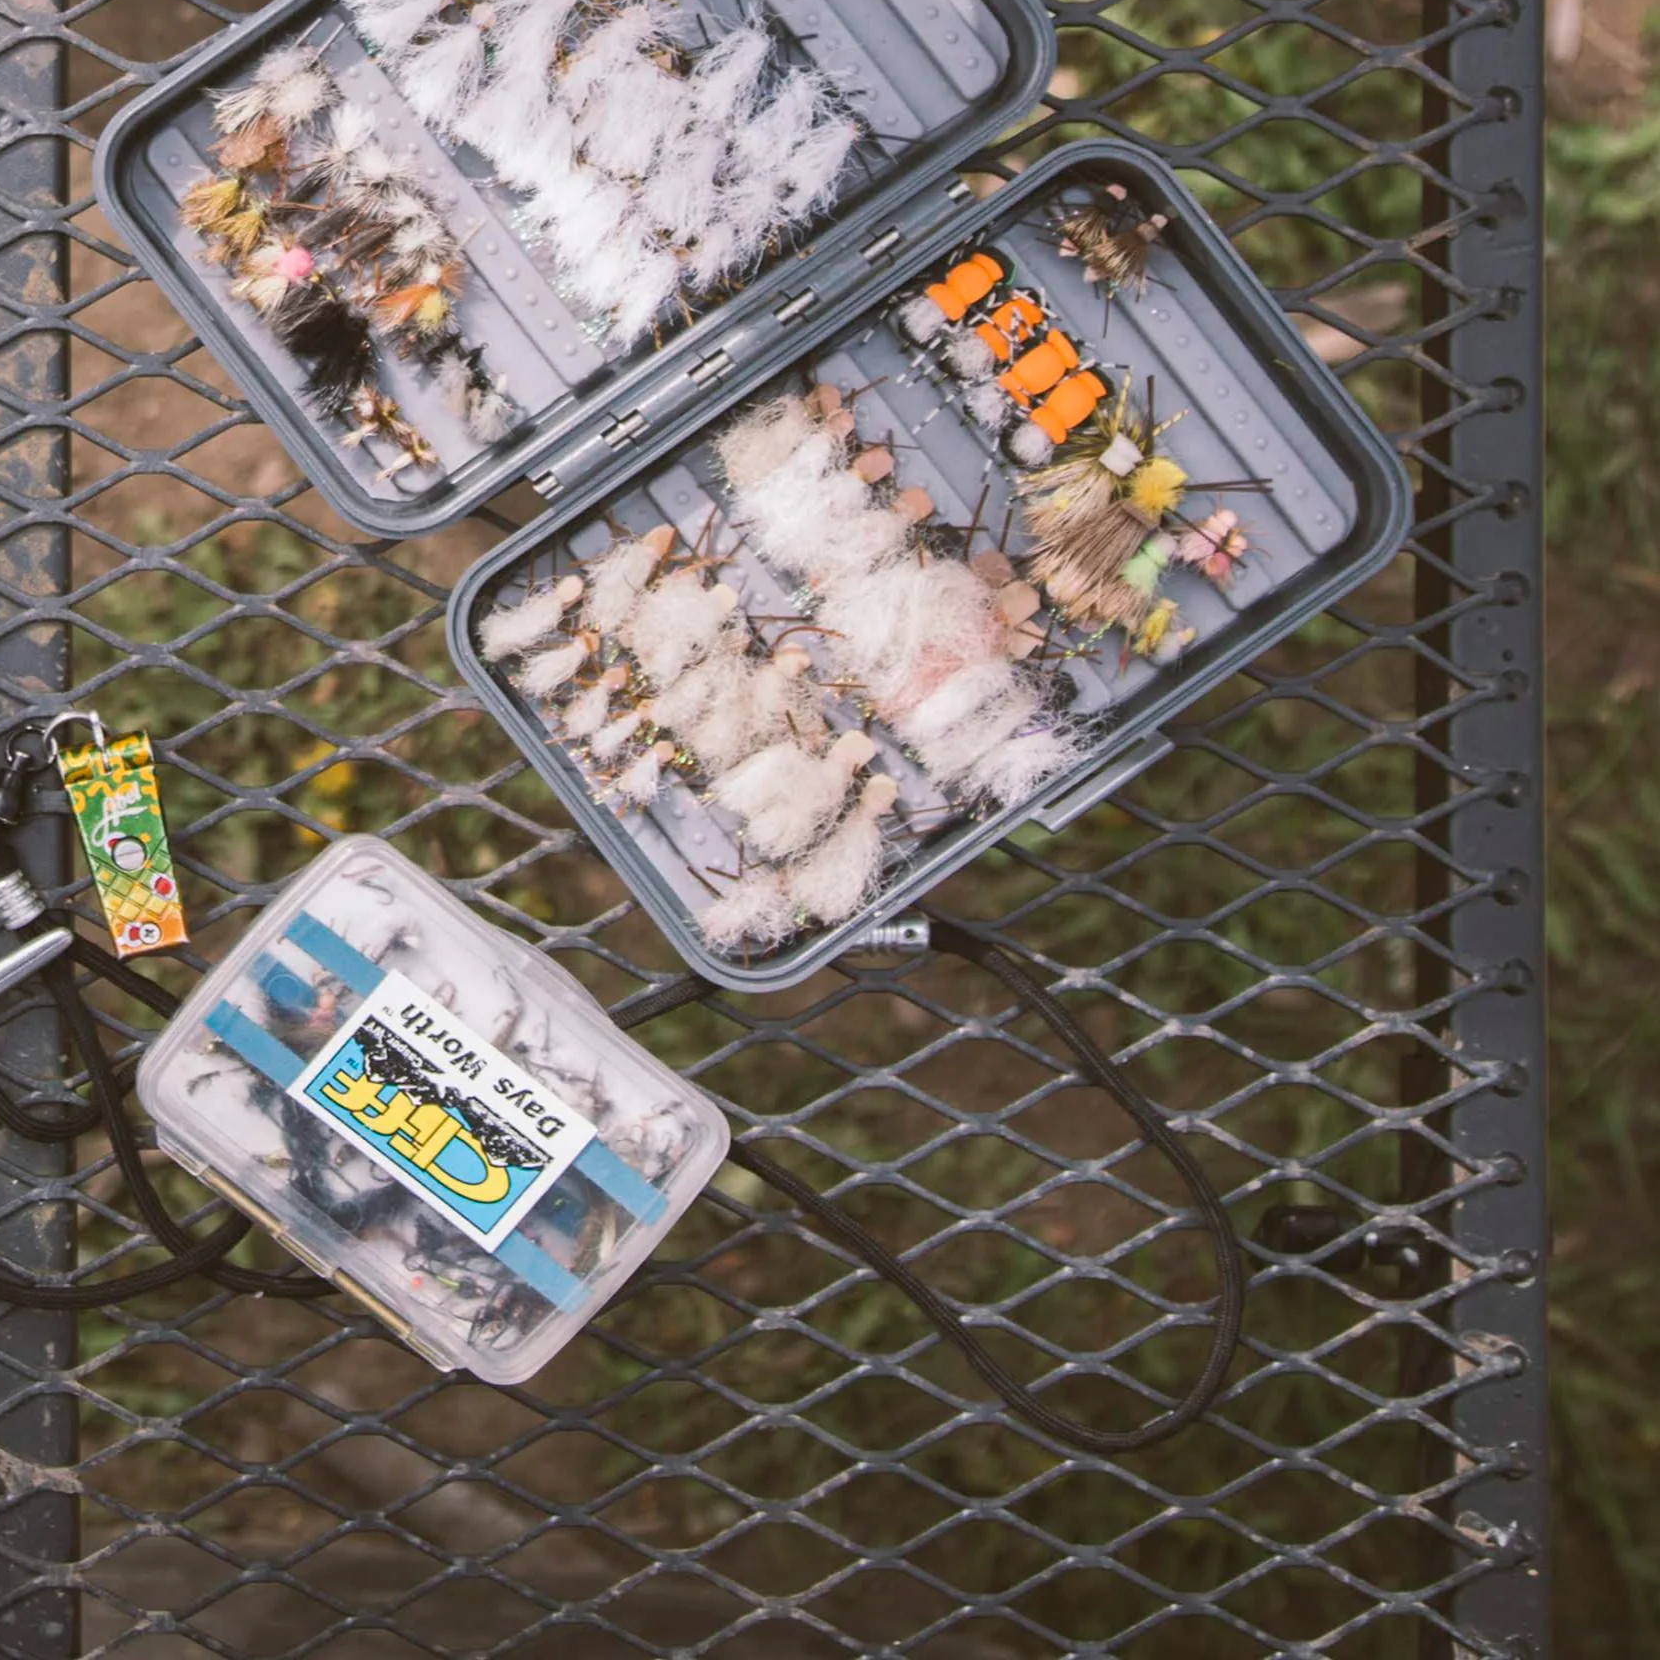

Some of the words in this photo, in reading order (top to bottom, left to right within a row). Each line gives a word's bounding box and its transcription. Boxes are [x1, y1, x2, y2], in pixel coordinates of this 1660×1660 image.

[400, 1003, 488, 1080] Worth
[321, 1068, 511, 1204] Cliff
[493, 1076, 567, 1139] Days
